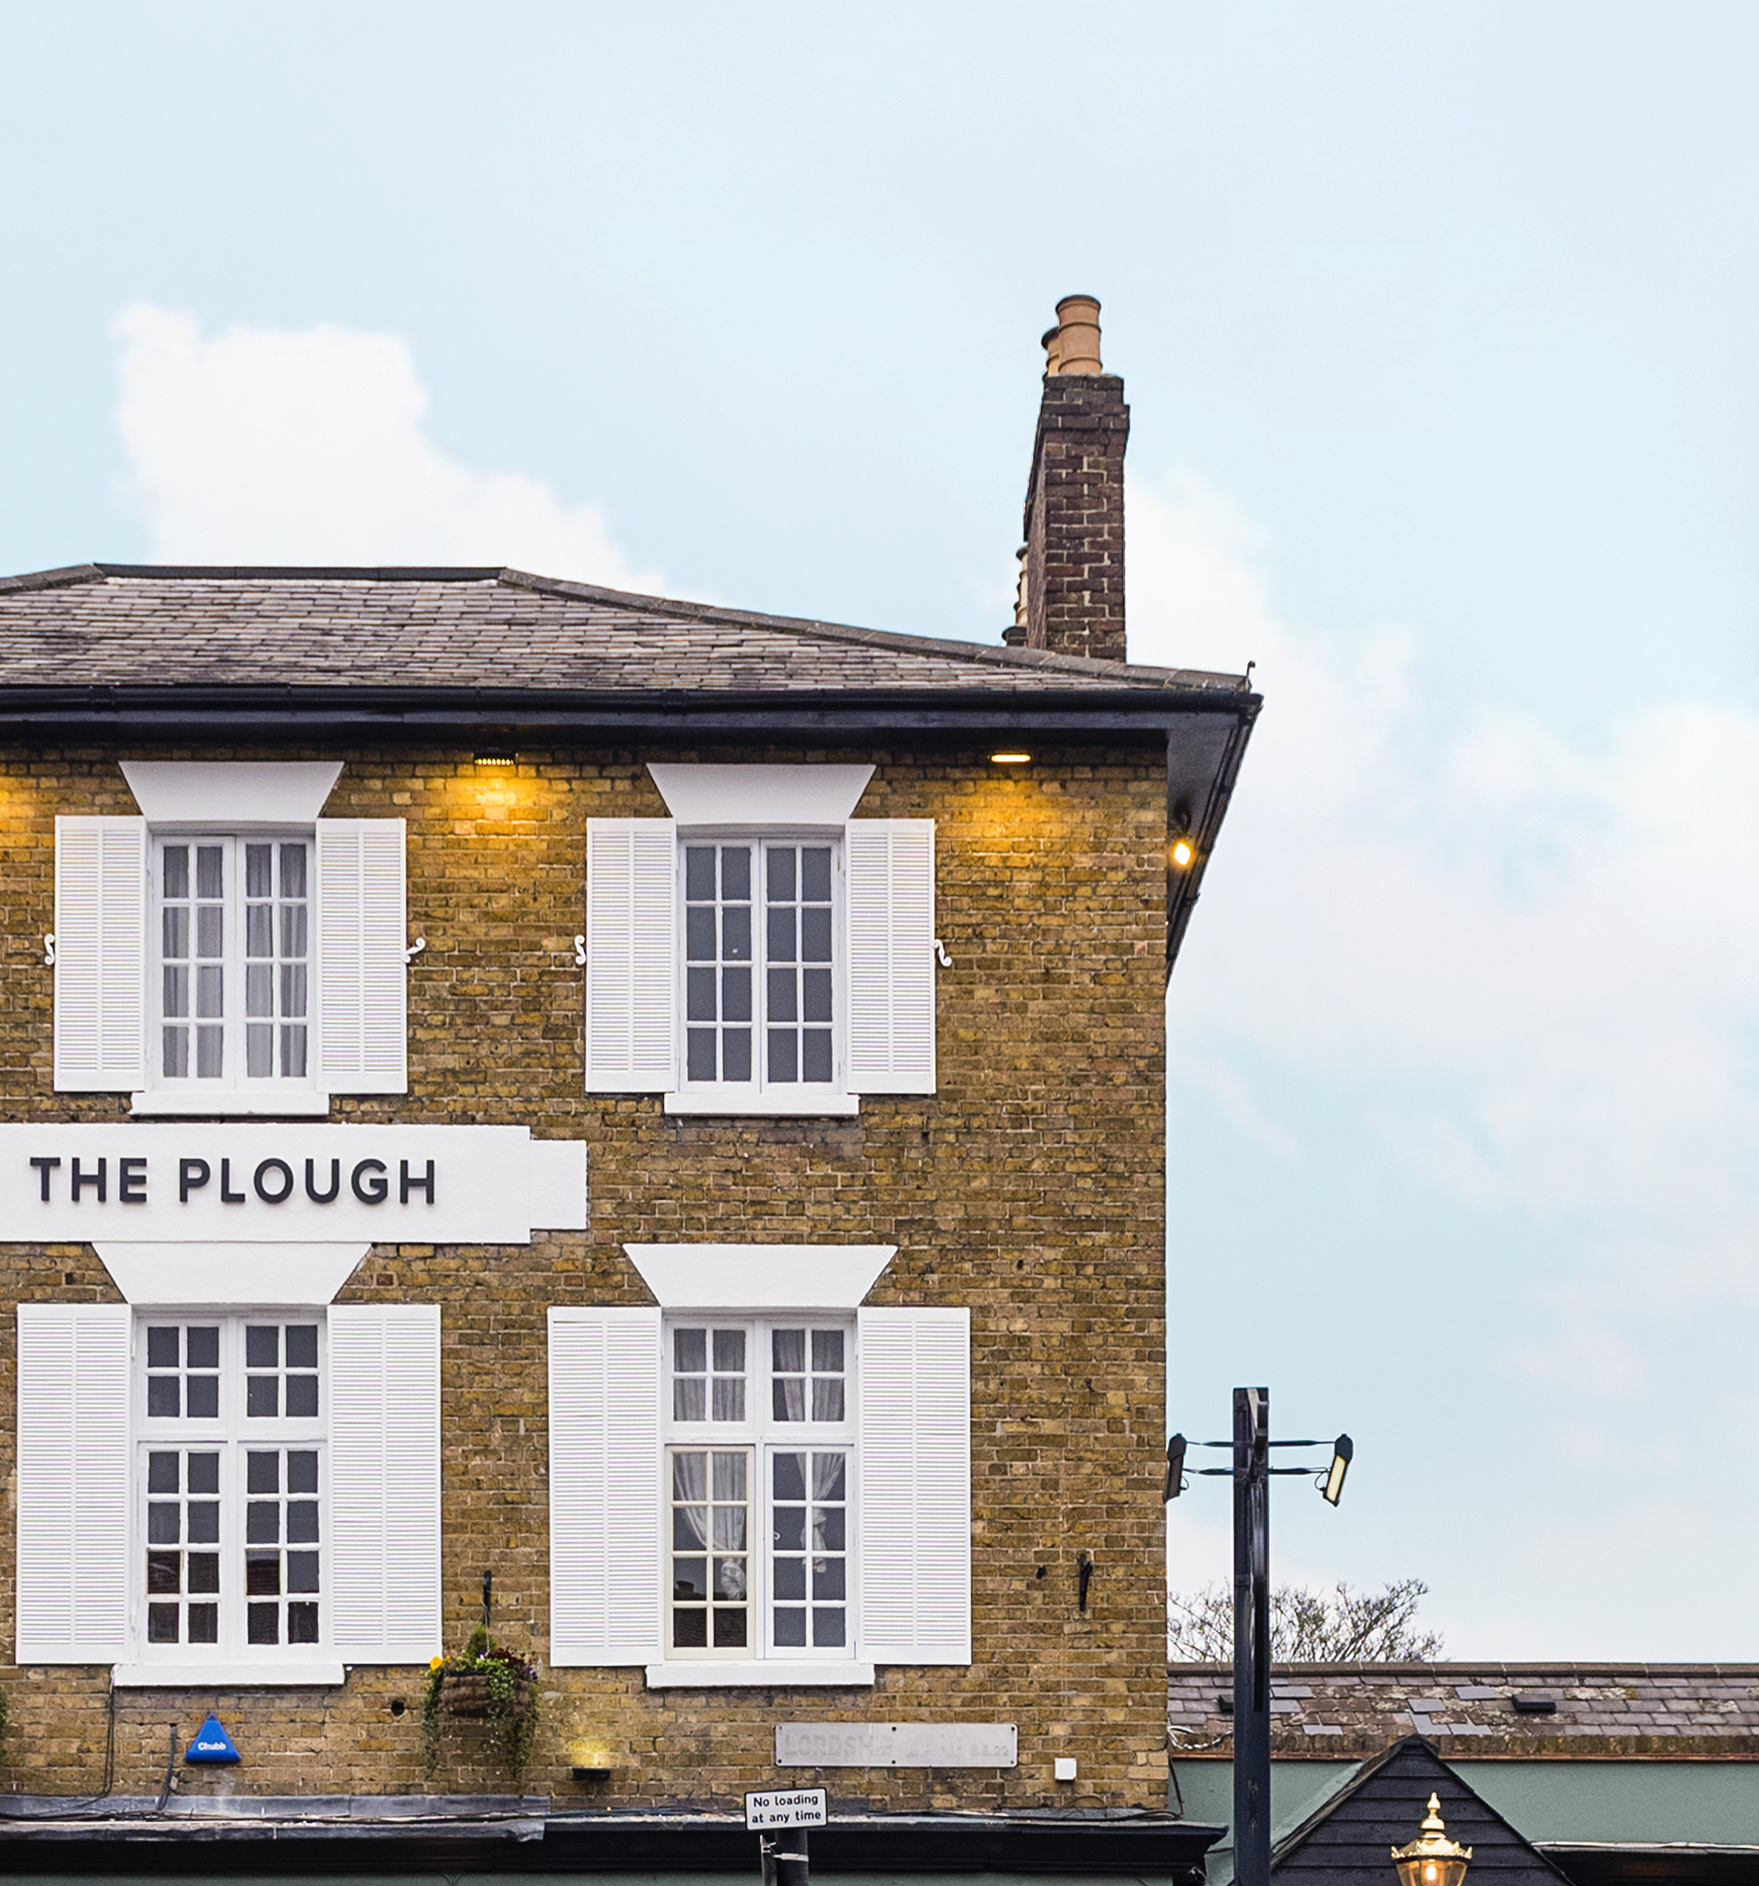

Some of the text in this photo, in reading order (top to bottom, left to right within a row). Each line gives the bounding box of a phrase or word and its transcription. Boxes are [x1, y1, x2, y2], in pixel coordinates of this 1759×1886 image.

[29, 1156, 436, 1204] THE PLOUGH
[198, 1741, 226, 1751] Chubb
[753, 1794, 818, 1807] No loading
[752, 1810, 821, 1824] at any time
